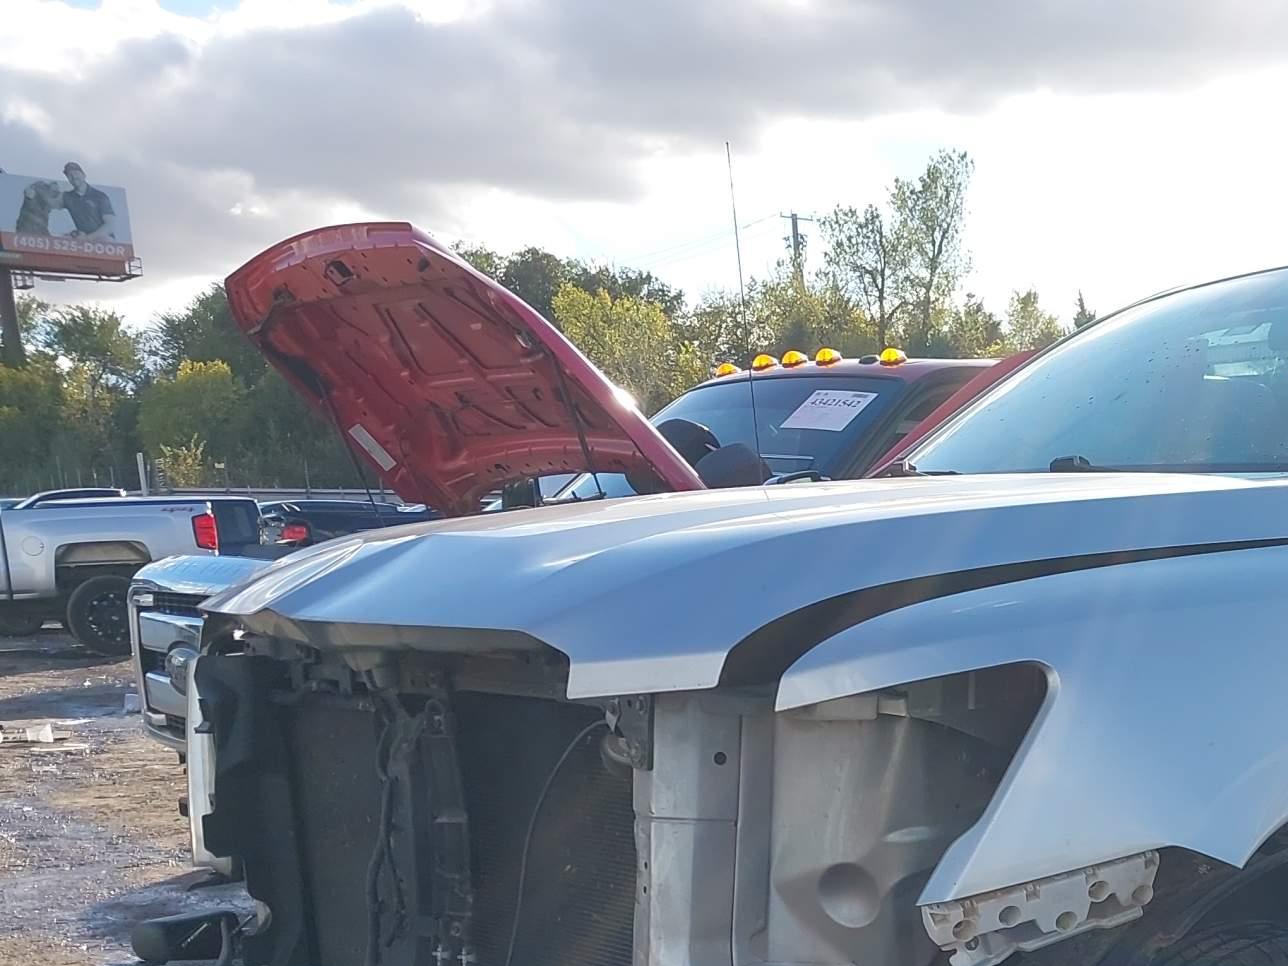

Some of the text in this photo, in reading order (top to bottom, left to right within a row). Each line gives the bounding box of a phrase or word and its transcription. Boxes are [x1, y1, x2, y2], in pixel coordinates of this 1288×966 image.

[13, 236, 126, 256] (405) 525-DOOR
[808, 398, 861, 408] 43421542
